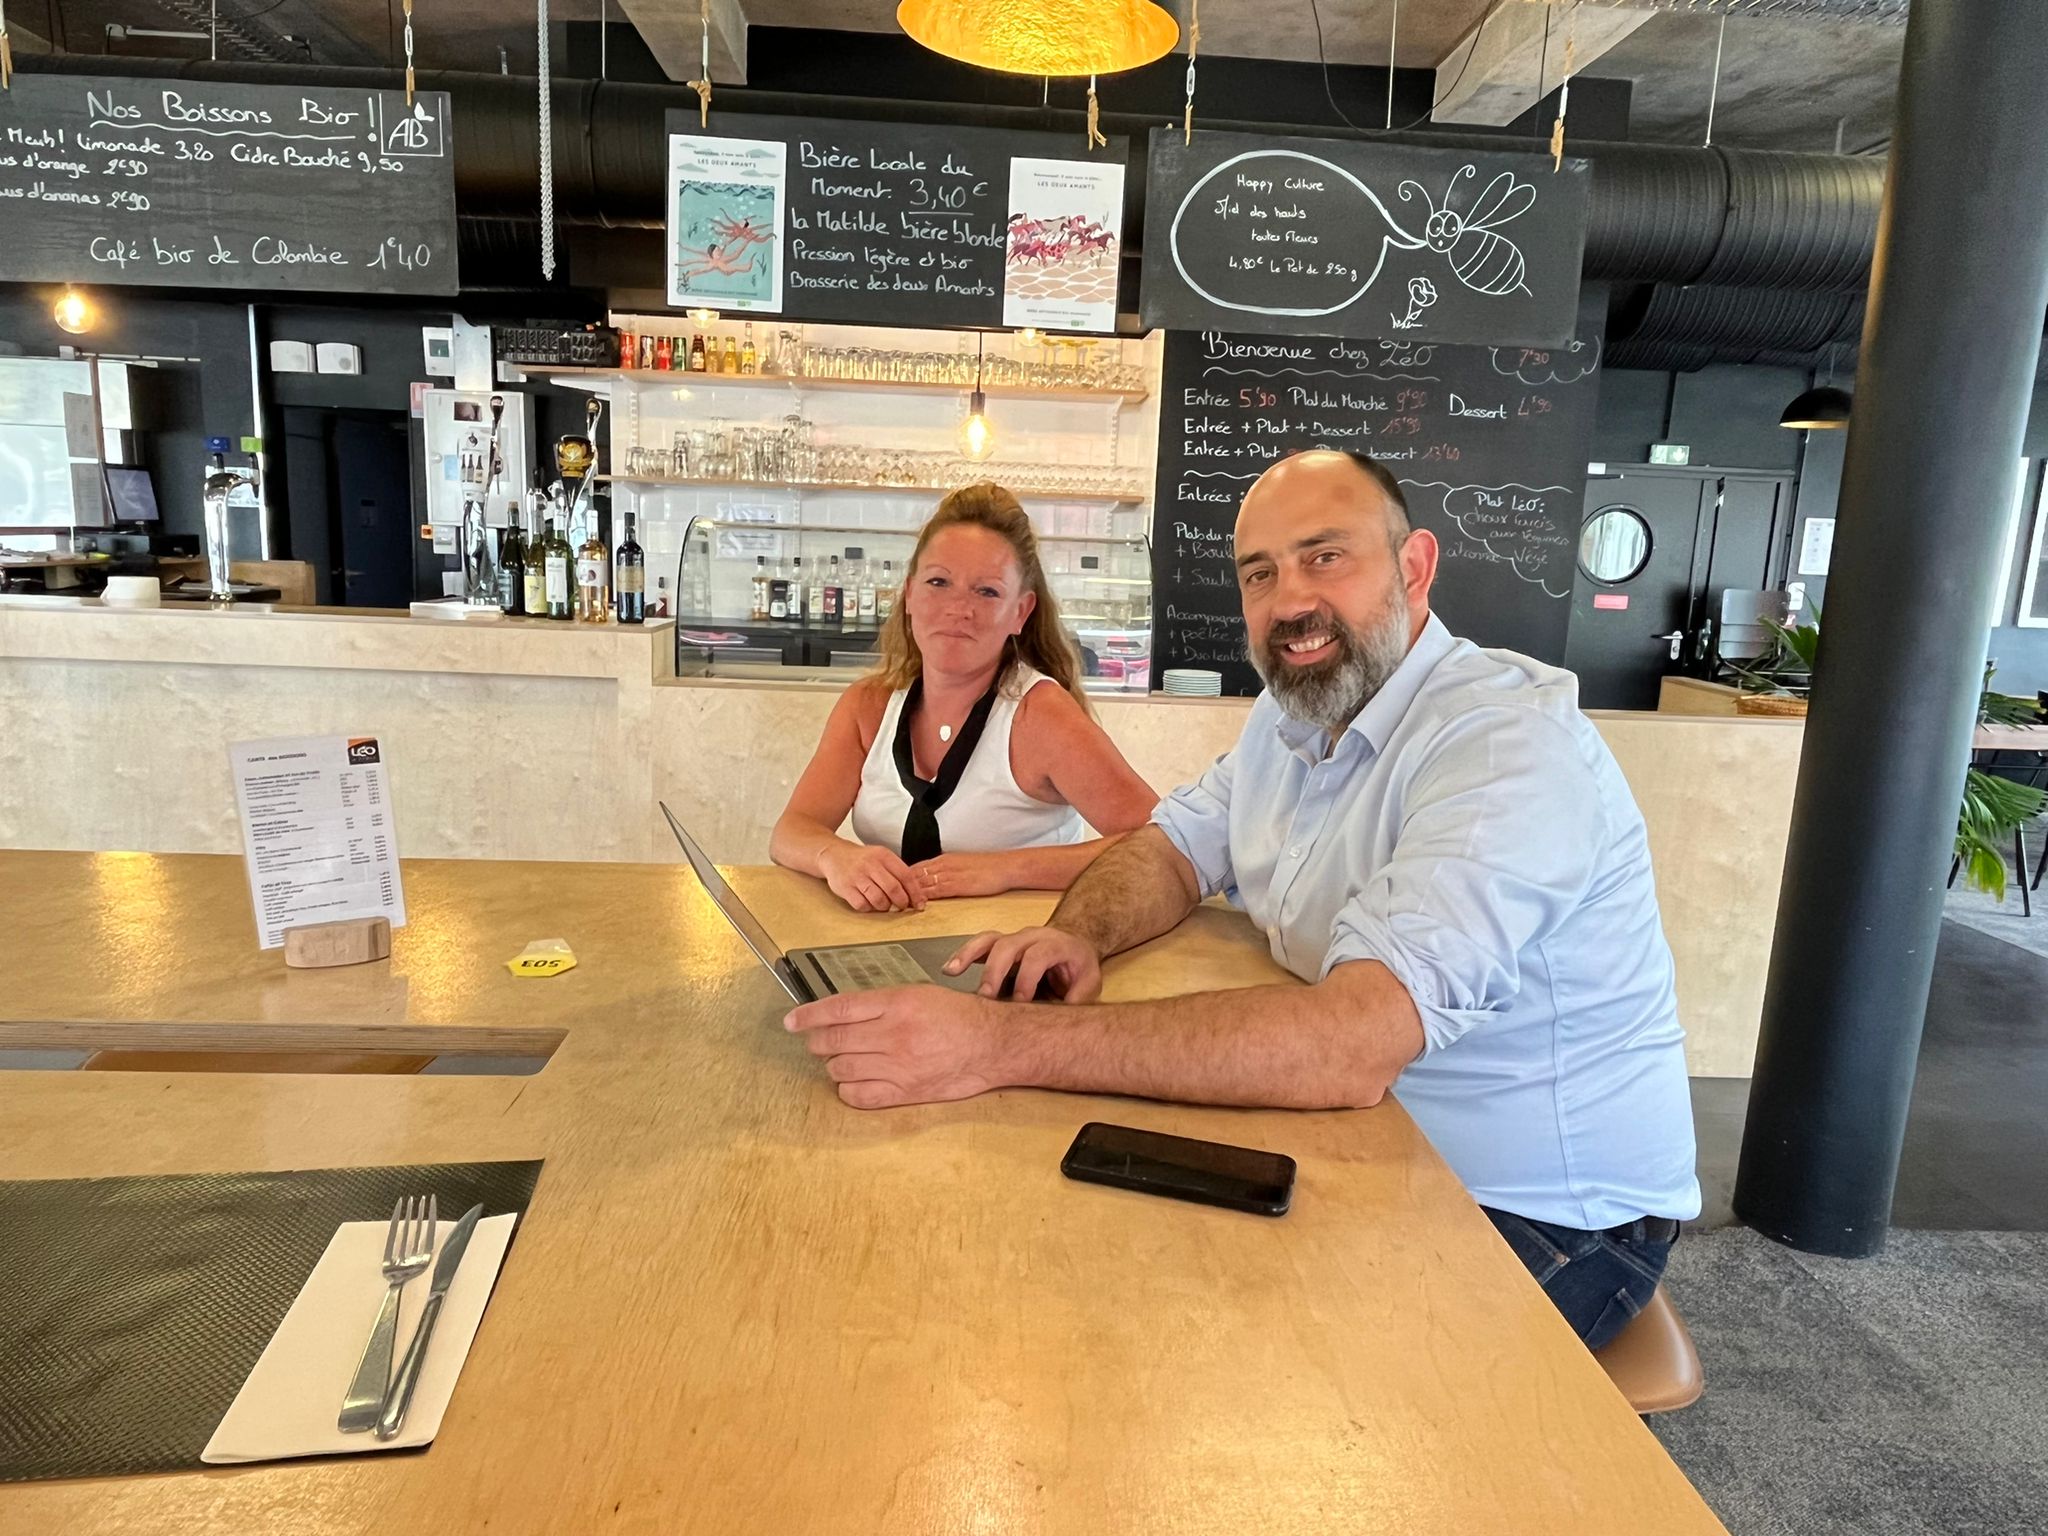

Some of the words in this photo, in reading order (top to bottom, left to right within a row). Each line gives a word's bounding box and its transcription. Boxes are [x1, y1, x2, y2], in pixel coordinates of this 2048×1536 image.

[87, 90, 141, 118] Nos
[162, 91, 272, 123] Boissons
[299, 97, 359, 124] Bio
[388, 118, 429, 149] AB
[0, 155, 18, 166] us
[23, 152, 90, 179] d'orange
[174, 140, 214, 161] 3,20
[230, 143, 280, 166] Cidre
[357, 151, 404, 174] 9,50
[800, 142, 861, 168] Bière
[871, 148, 927, 170] Locale
[941, 154, 974, 177] du
[0, 187, 24, 198] us
[1285, 178, 1324, 192] Culture
[1250, 205, 1267, 218] des
[817, 210, 890, 235] Matilde
[901, 212, 948, 241] bière
[953, 219, 1005, 249] blonde
[1251, 228, 1280, 242] toutes
[90, 237, 141, 269] Café
[153, 237, 195, 265] bio
[208, 235, 239, 264] de
[252, 236, 348, 265] Colombie
[792, 239, 855, 263] Pression
[865, 247, 910, 273] légère
[919, 251, 935, 266] et
[941, 253, 973, 269] bio
[1283, 257, 1303, 273] Pot
[1306, 264, 1319, 275] de
[790, 271, 859, 289] Brasserie
[867, 274, 888, 291] des
[935, 274, 995, 296] Amants
[1202, 331, 1316, 360] Bienvenue
[1329, 342, 1370, 369] chez
[1184, 388, 1231, 407] Entrée
[1287, 386, 1319, 407] Plat
[1321, 393, 1338, 408] du
[1449, 393, 1508, 420] Dessert
[1184, 416, 1232, 435] Entrée
[1255, 418, 1290, 434] Plat
[1310, 421, 1372, 437] Dessert
[1183, 440, 1230, 458] Entrée
[1247, 442, 1281, 459] Plat
[1178, 483, 1231, 503] Entrées
[1473, 491, 1504, 507] Plat
